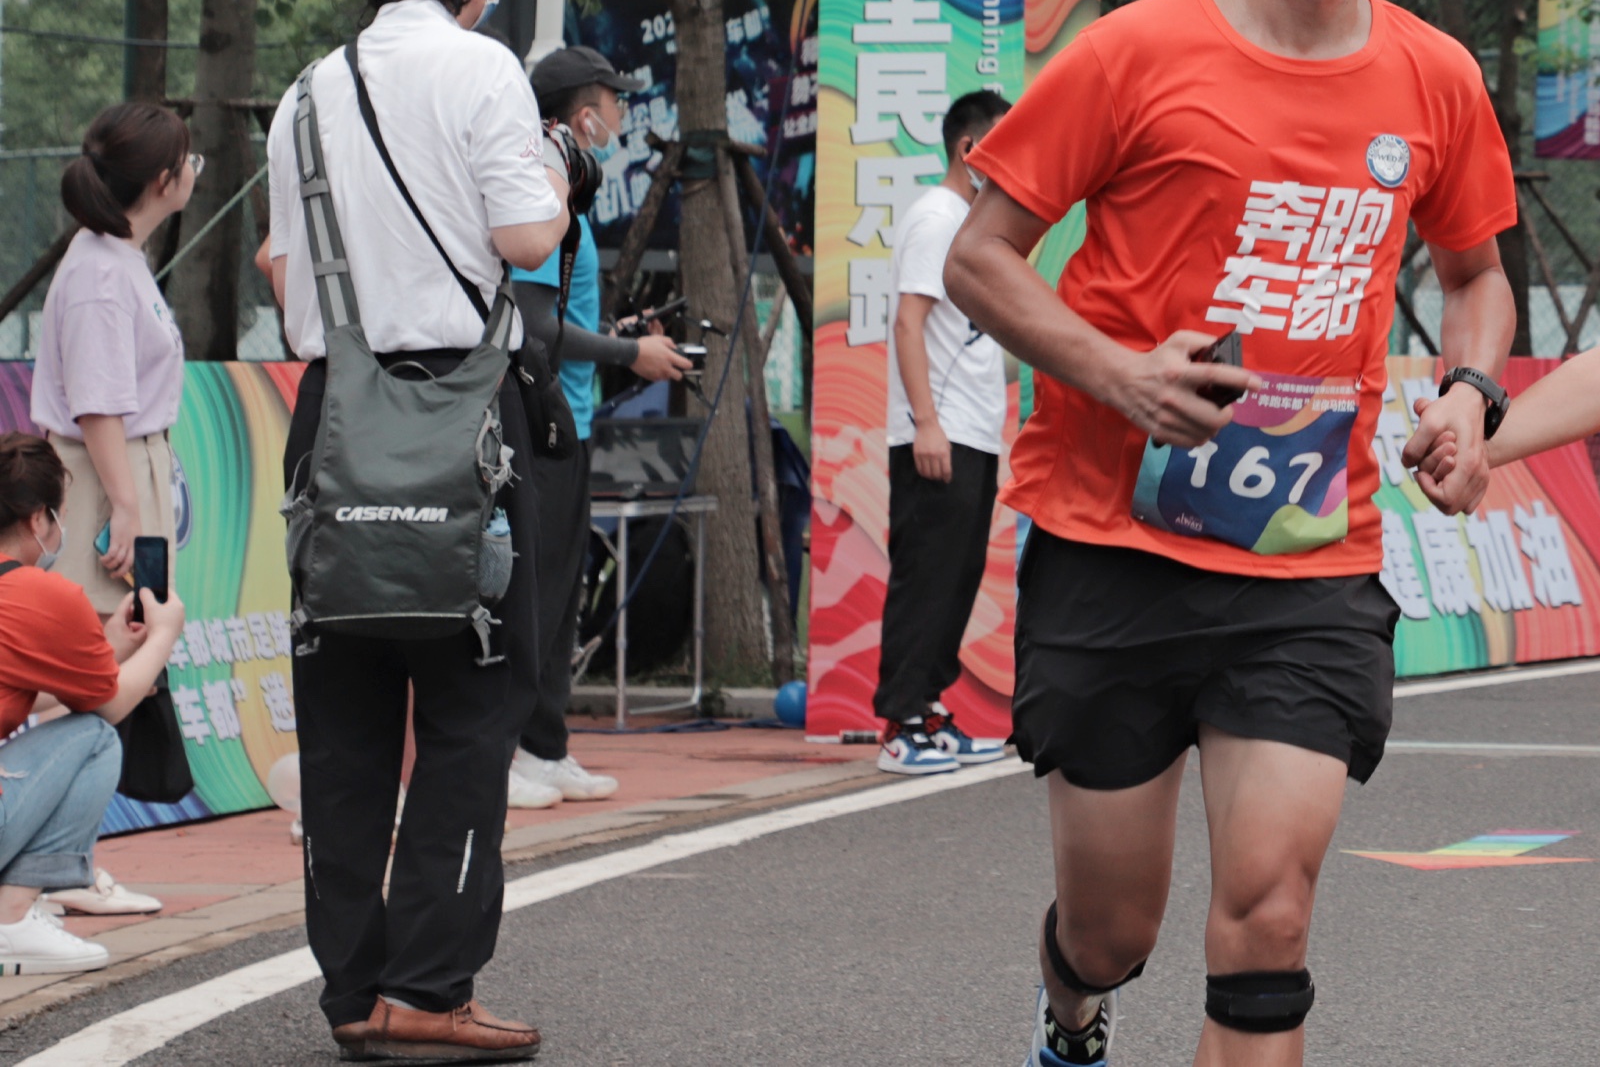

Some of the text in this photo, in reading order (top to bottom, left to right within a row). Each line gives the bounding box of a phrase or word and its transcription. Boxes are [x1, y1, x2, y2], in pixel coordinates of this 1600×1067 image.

[1235, 180, 1394, 265] 奔跑
[1205, 256, 1372, 341] 车都
[1187, 440, 1324, 505] 167
[335, 505, 449, 523] CASEMAN
